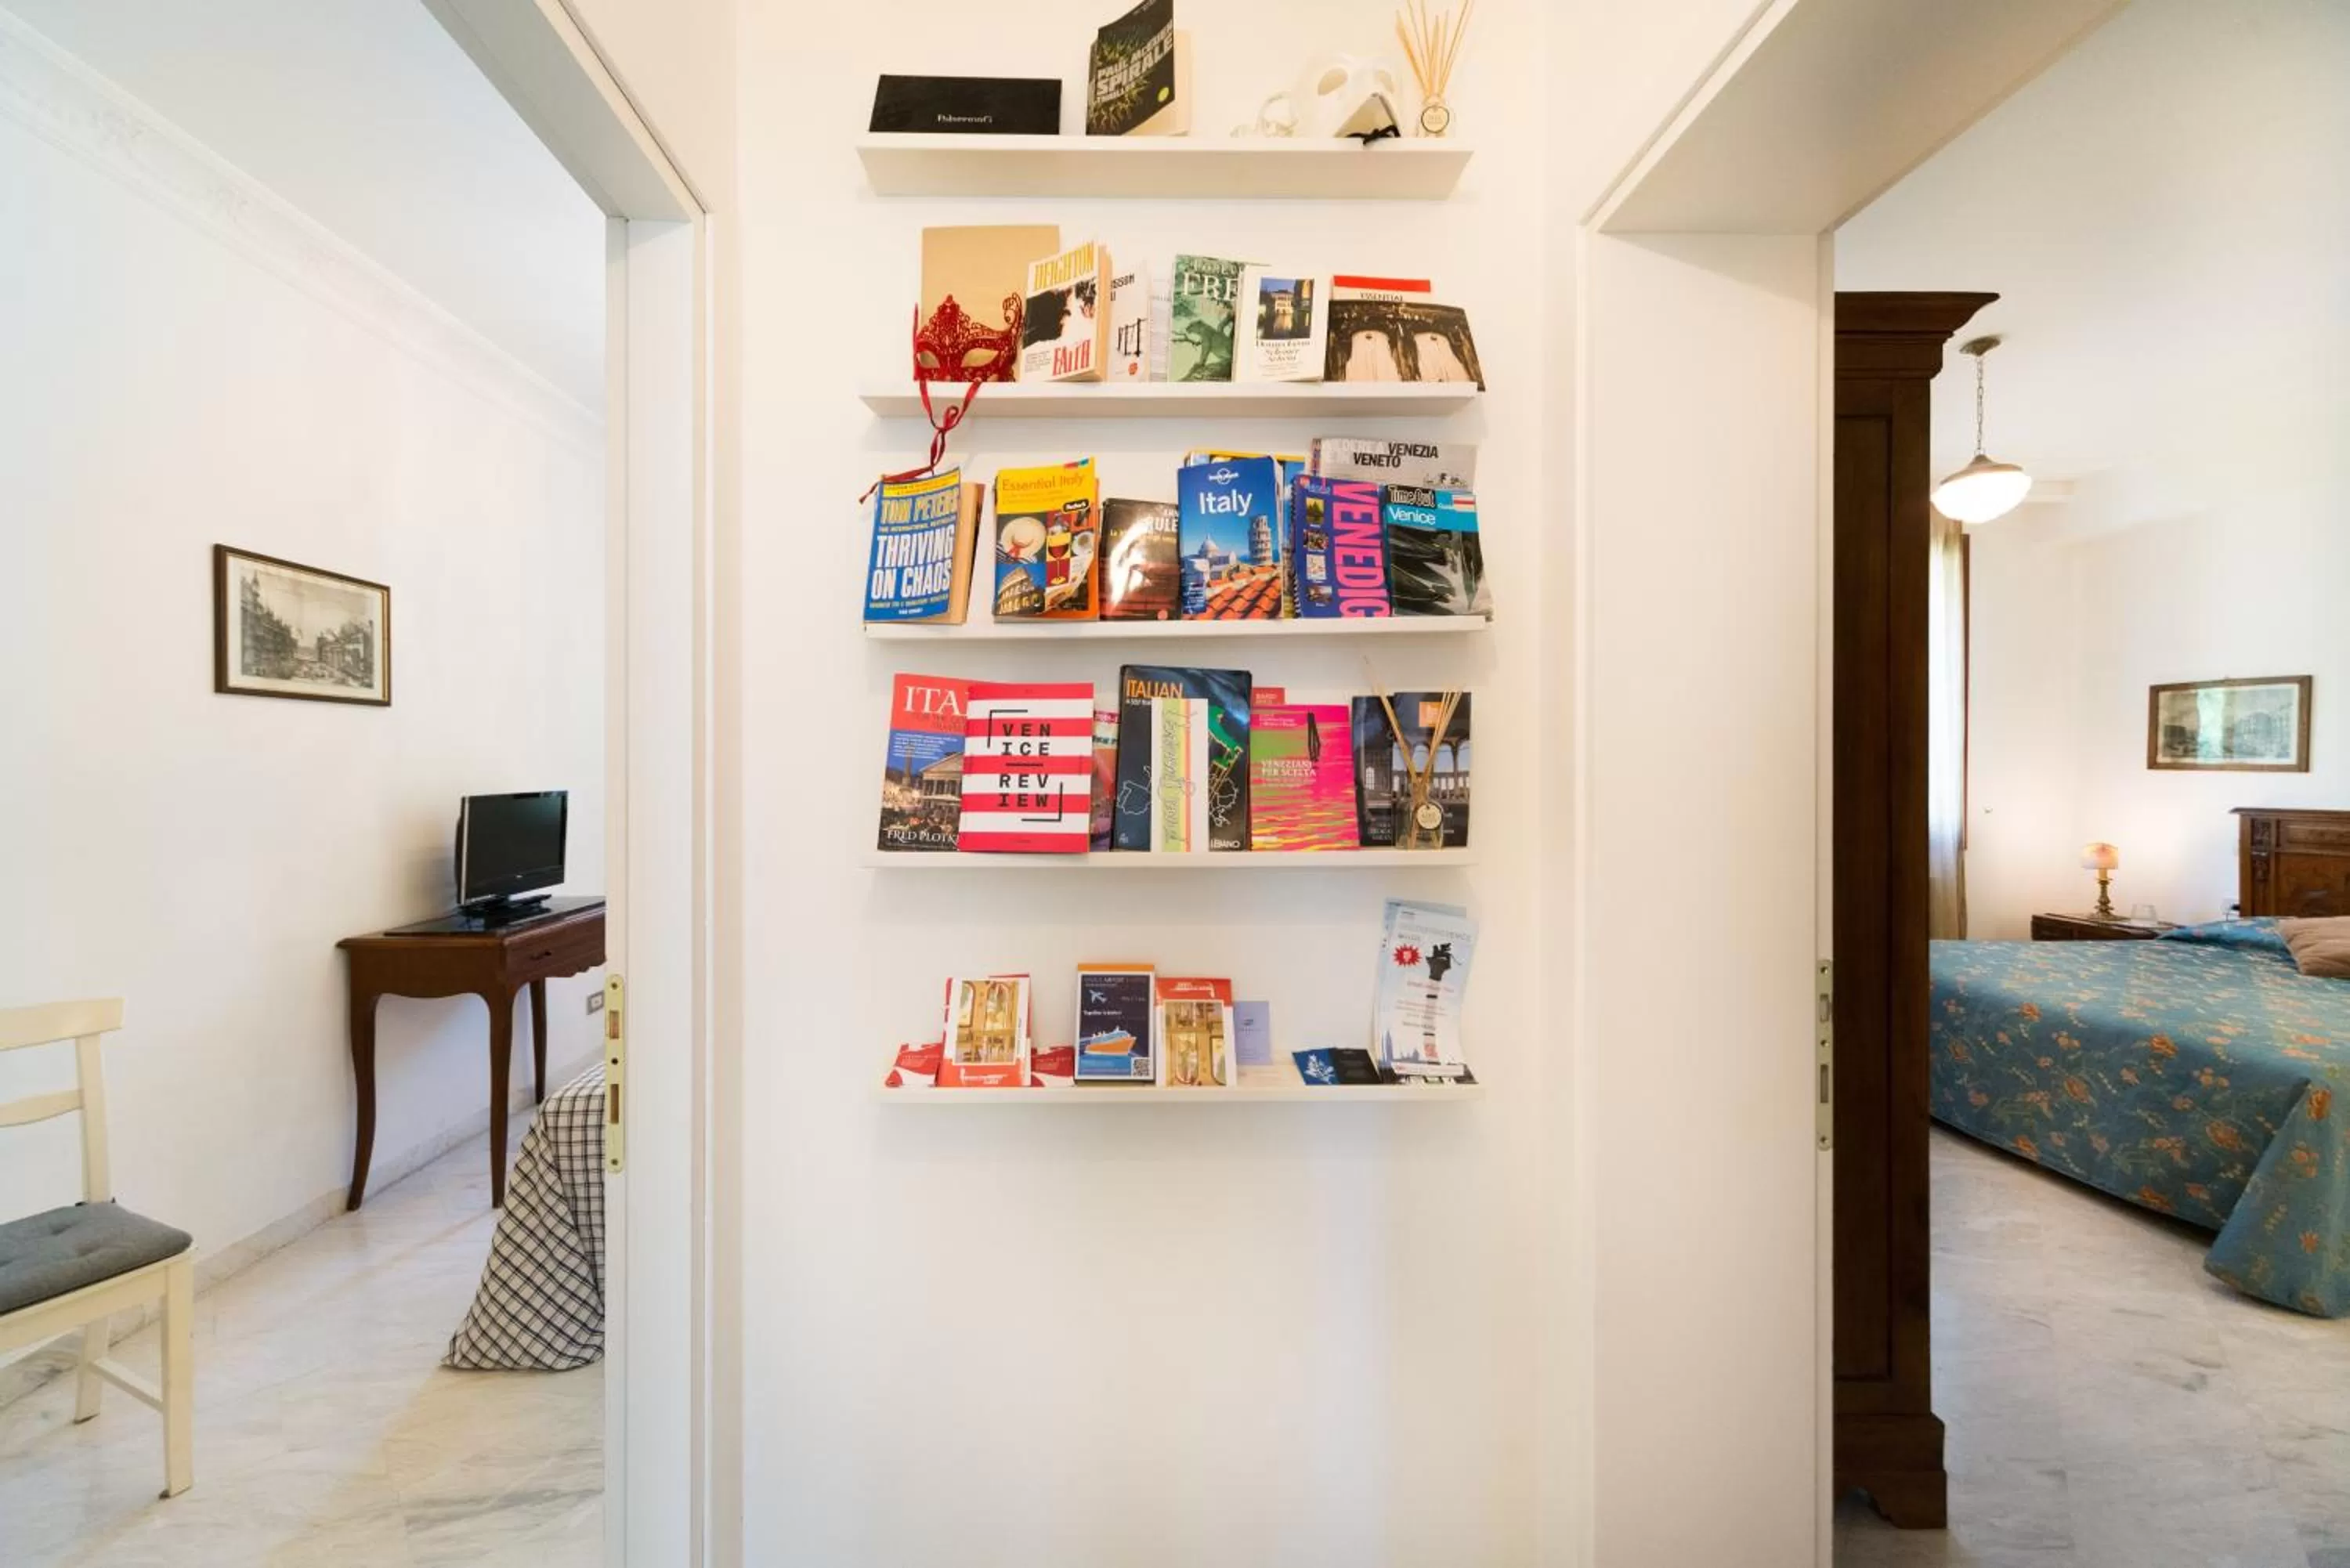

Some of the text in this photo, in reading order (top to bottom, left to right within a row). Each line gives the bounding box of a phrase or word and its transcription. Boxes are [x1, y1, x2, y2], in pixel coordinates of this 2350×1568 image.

[1097, 30, 1173, 95] SPIRALE
[1388, 442, 1439, 458] VENEZIA
[1354, 452, 1401, 468] VENETO
[1002, 472, 1085, 491] Essential Italy
[1198, 489, 1253, 517] Italy
[1389, 507, 1436, 526] Venice
[877, 524, 955, 568] THRIVING
[870, 558, 953, 600] ON CHAOS
[1126, 679, 1184, 699] ITALIAN
[904, 685, 967, 717] ITA
[1002, 723, 1051, 737] VEN
[1000, 742, 1050, 757] ICE
[999, 774, 1050, 789] REV
[997, 793, 1049, 807] IEW
